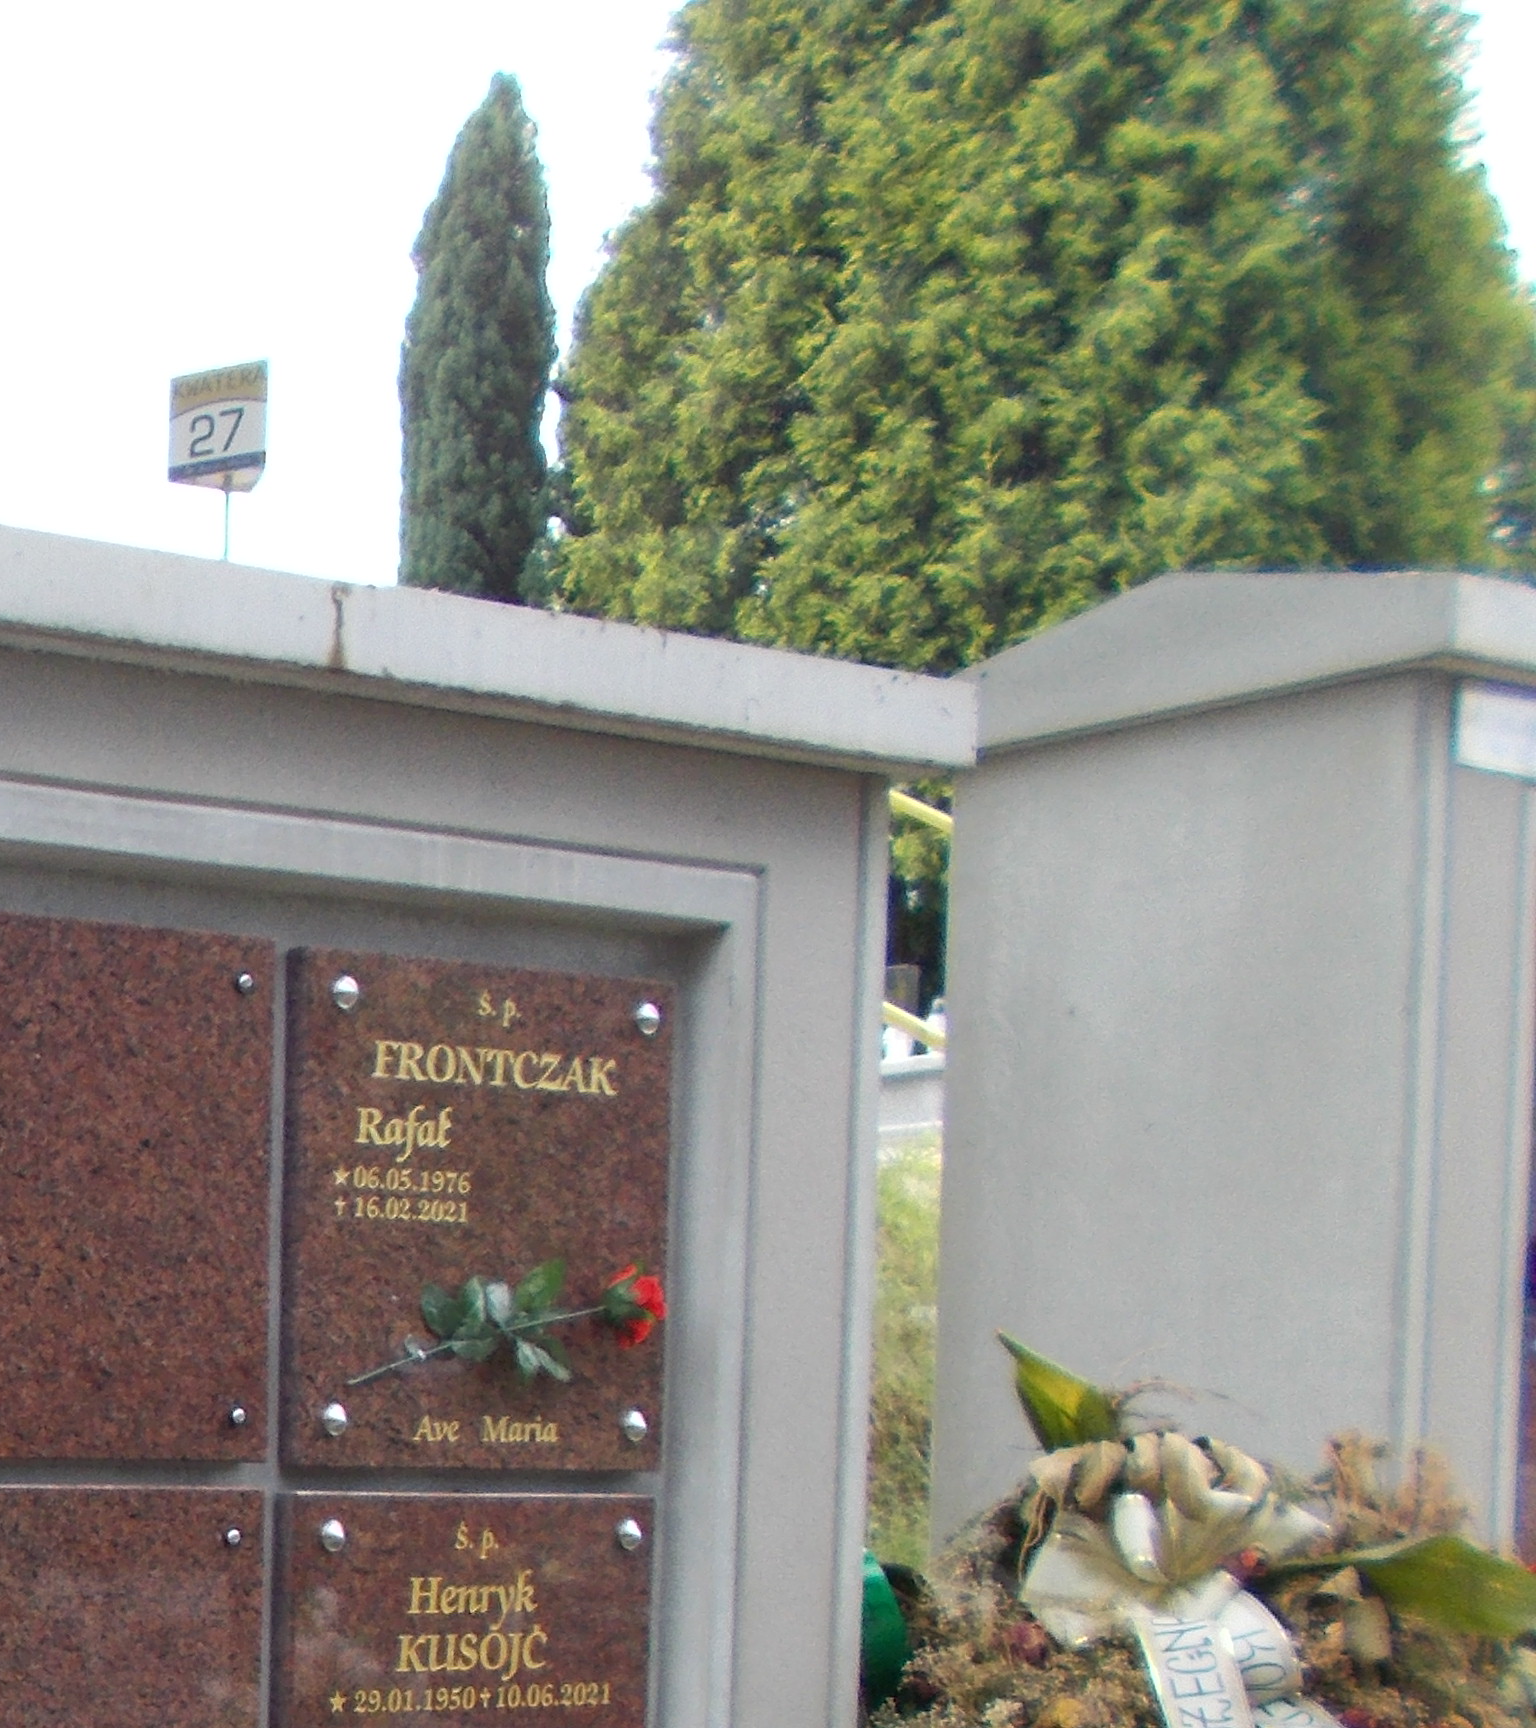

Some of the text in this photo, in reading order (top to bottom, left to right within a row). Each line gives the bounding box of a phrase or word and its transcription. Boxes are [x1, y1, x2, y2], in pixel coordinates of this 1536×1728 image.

[190, 407, 244, 458] 27
[372, 1040, 618, 1096] FRONTCZAK
[355, 1106, 453, 1162] Rafał
[413, 1416, 559, 1443] Ave Maria
[407, 1569, 537, 1630] Henryk
